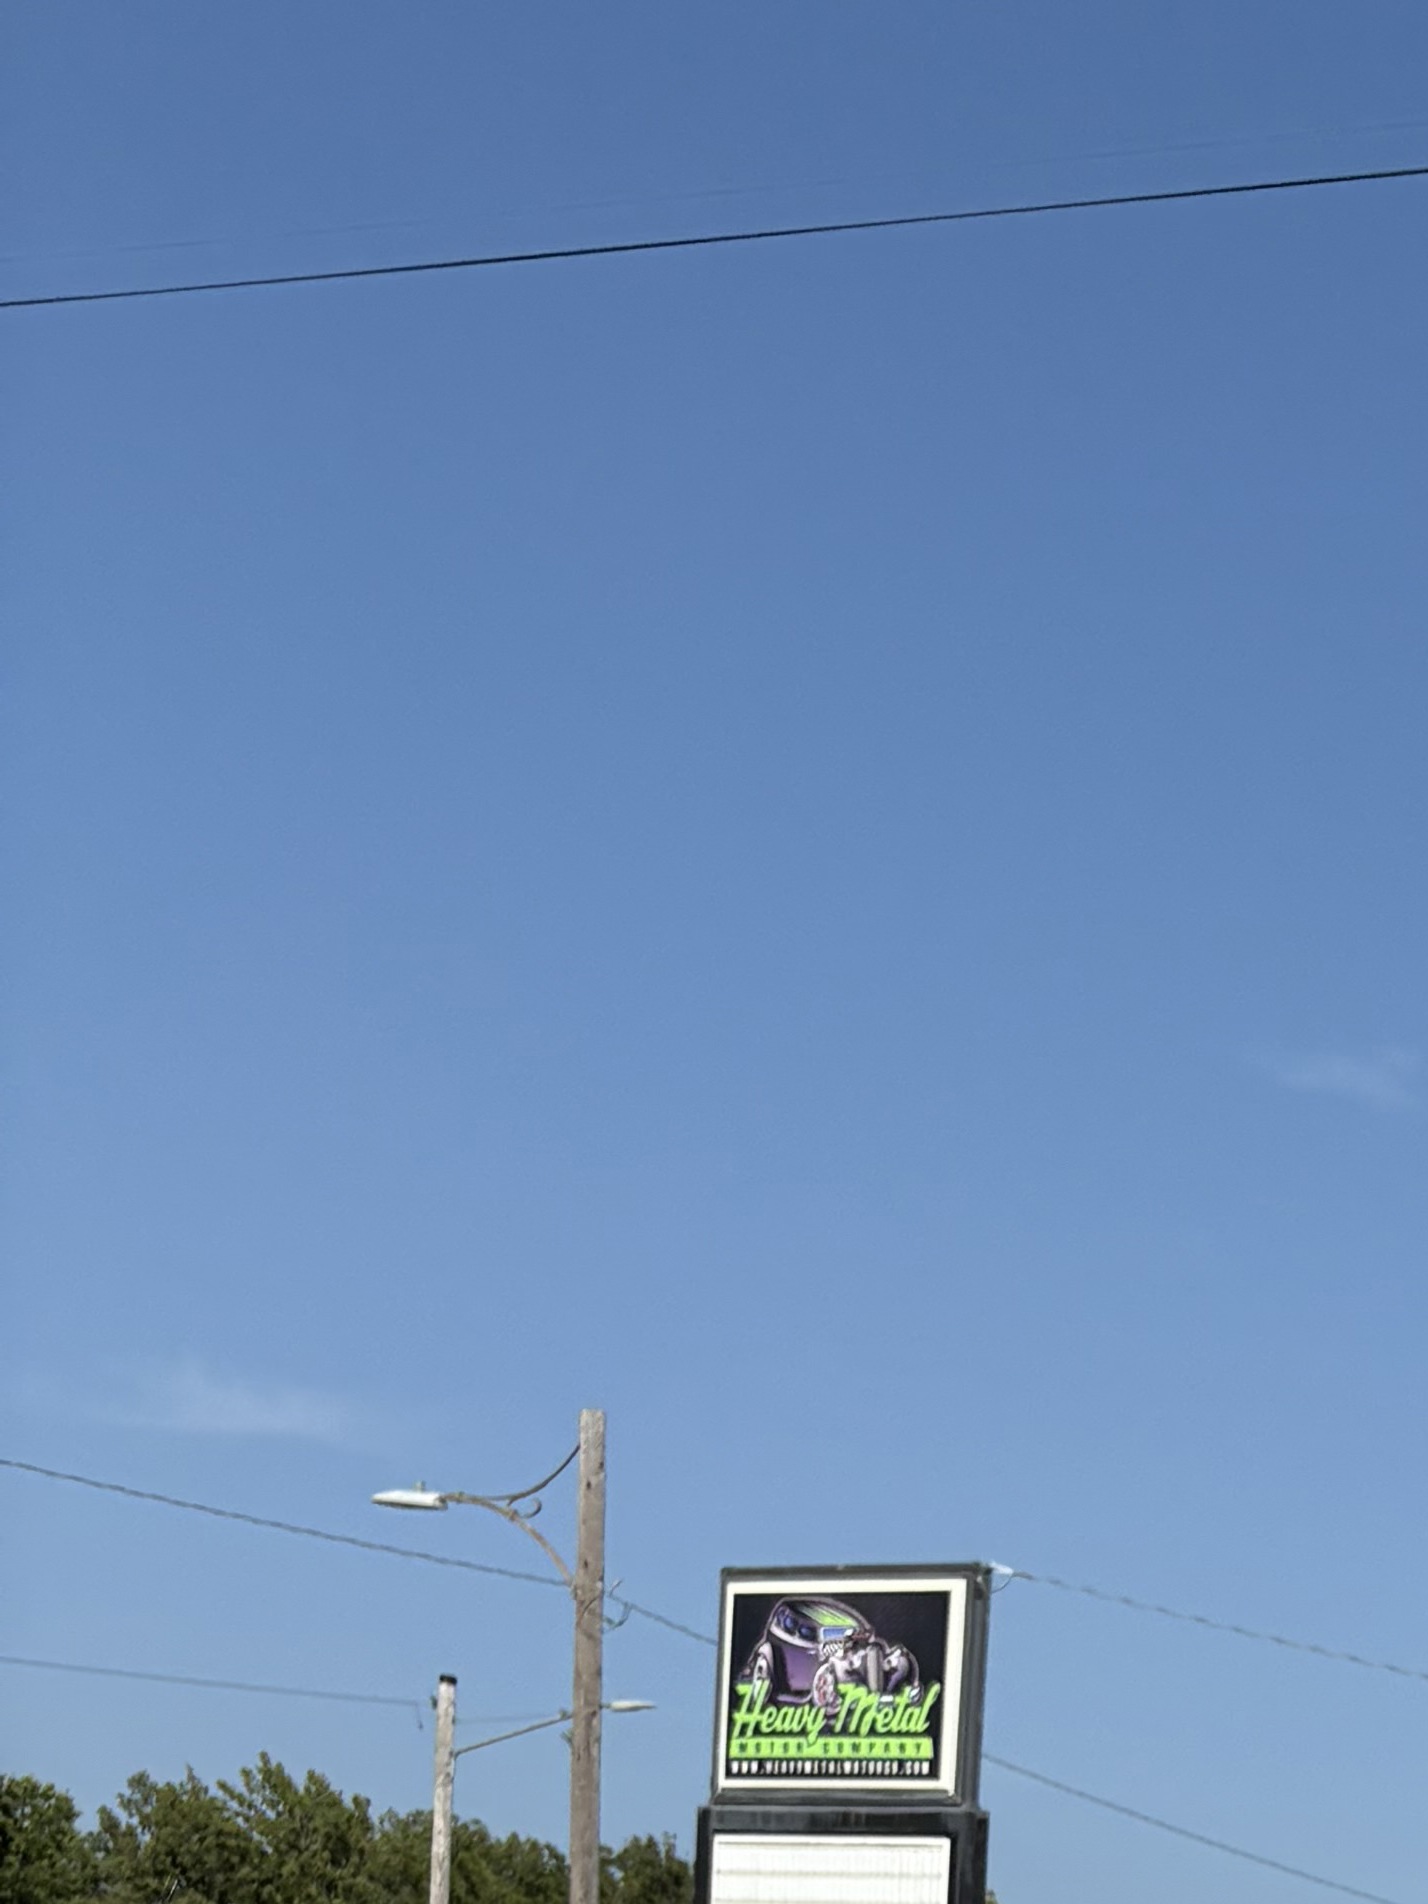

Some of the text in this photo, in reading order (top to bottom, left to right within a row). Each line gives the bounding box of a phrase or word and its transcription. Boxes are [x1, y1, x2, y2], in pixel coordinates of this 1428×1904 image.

[730, 1678, 941, 1748] Heavy Metal
[738, 1741, 923, 1755] MOTOR COMPANY
